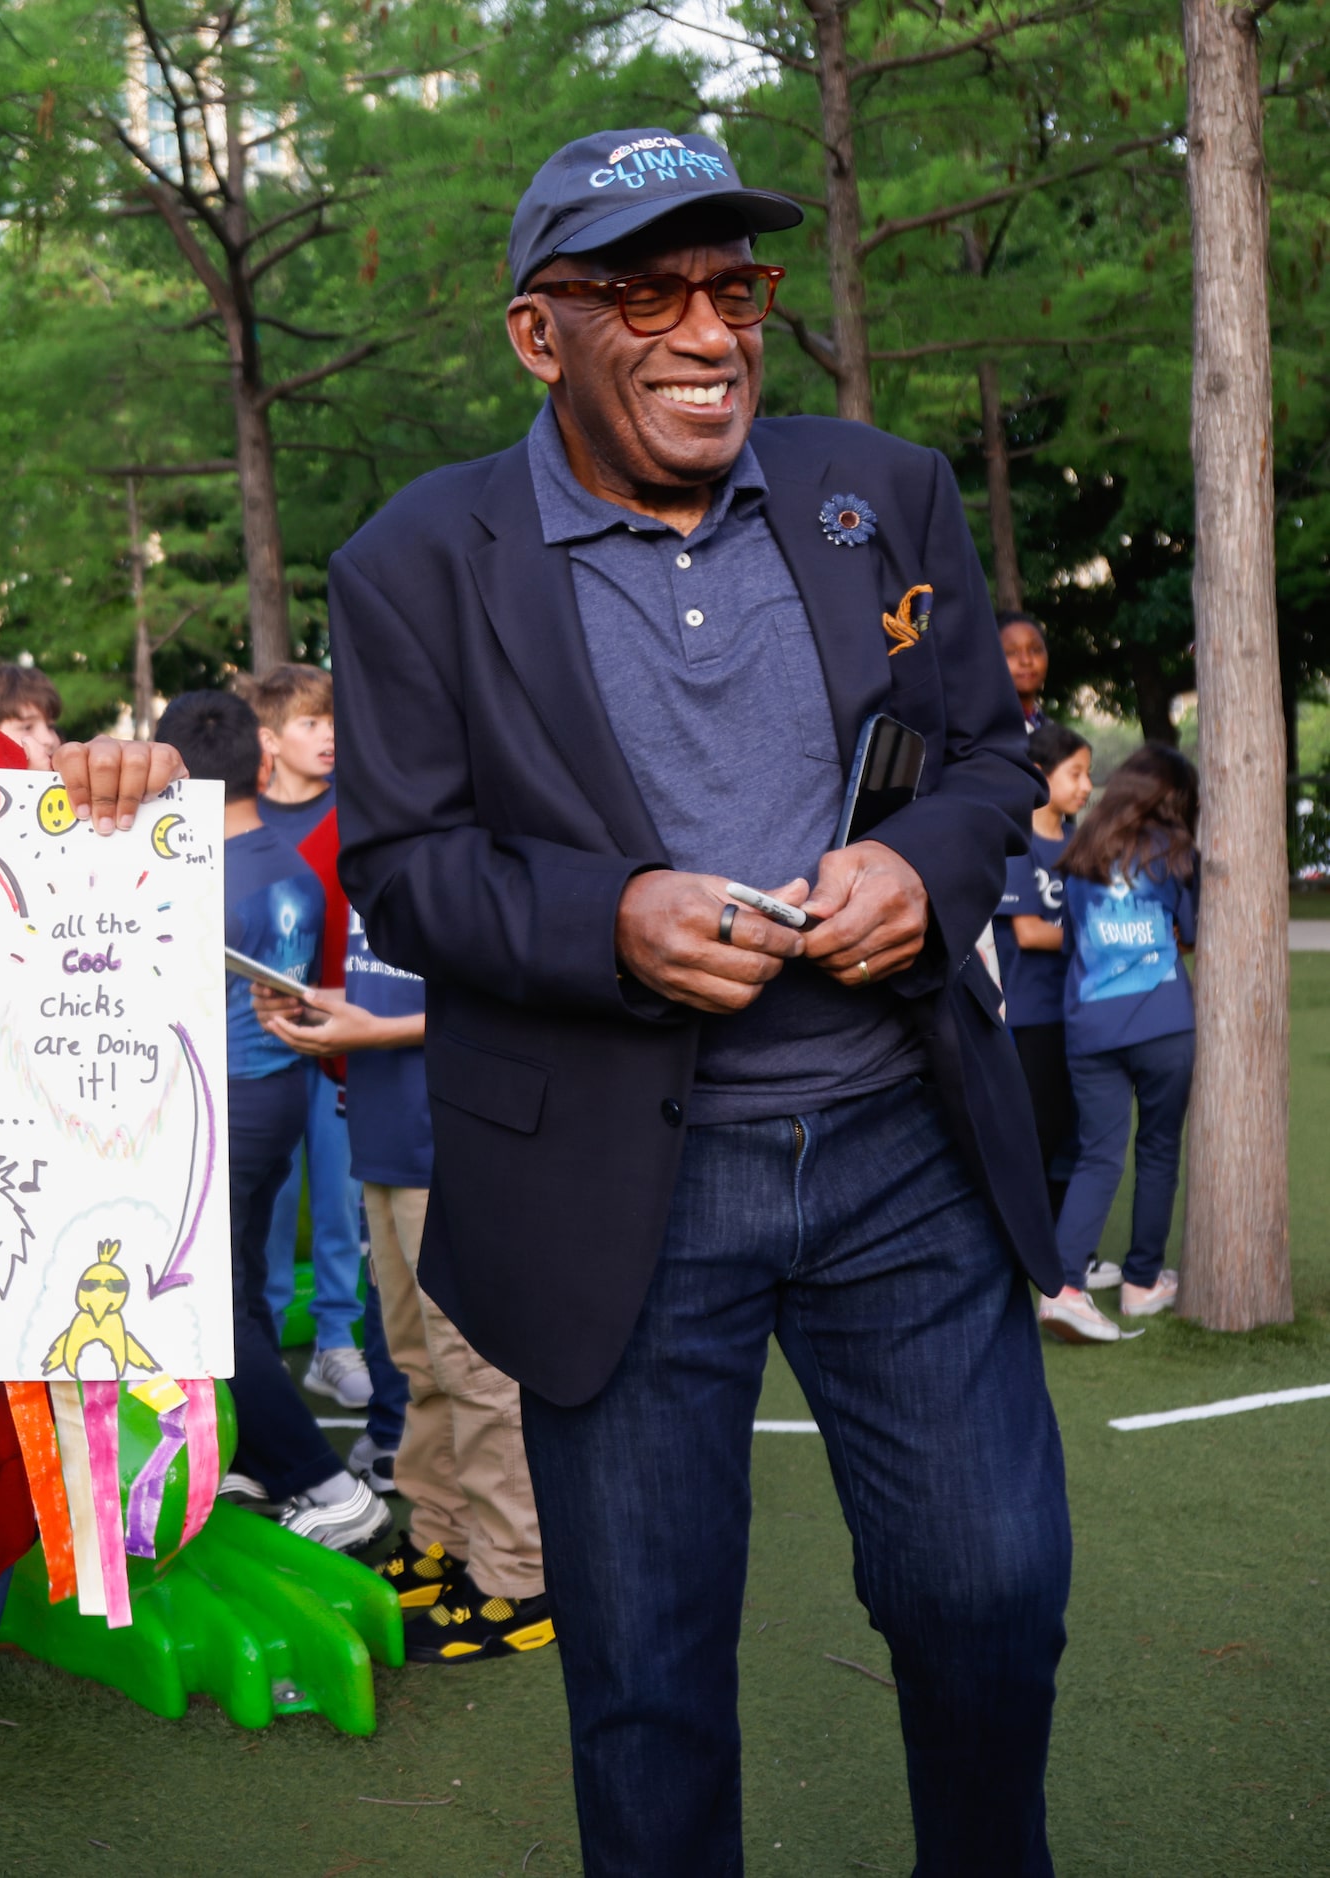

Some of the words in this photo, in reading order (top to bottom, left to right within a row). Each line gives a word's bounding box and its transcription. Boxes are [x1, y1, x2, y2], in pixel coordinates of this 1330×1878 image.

[51, 914, 87, 940] all
[96, 912, 142, 935] the
[34, 1034, 81, 1056] are
[78, 1061, 119, 1110] it!
